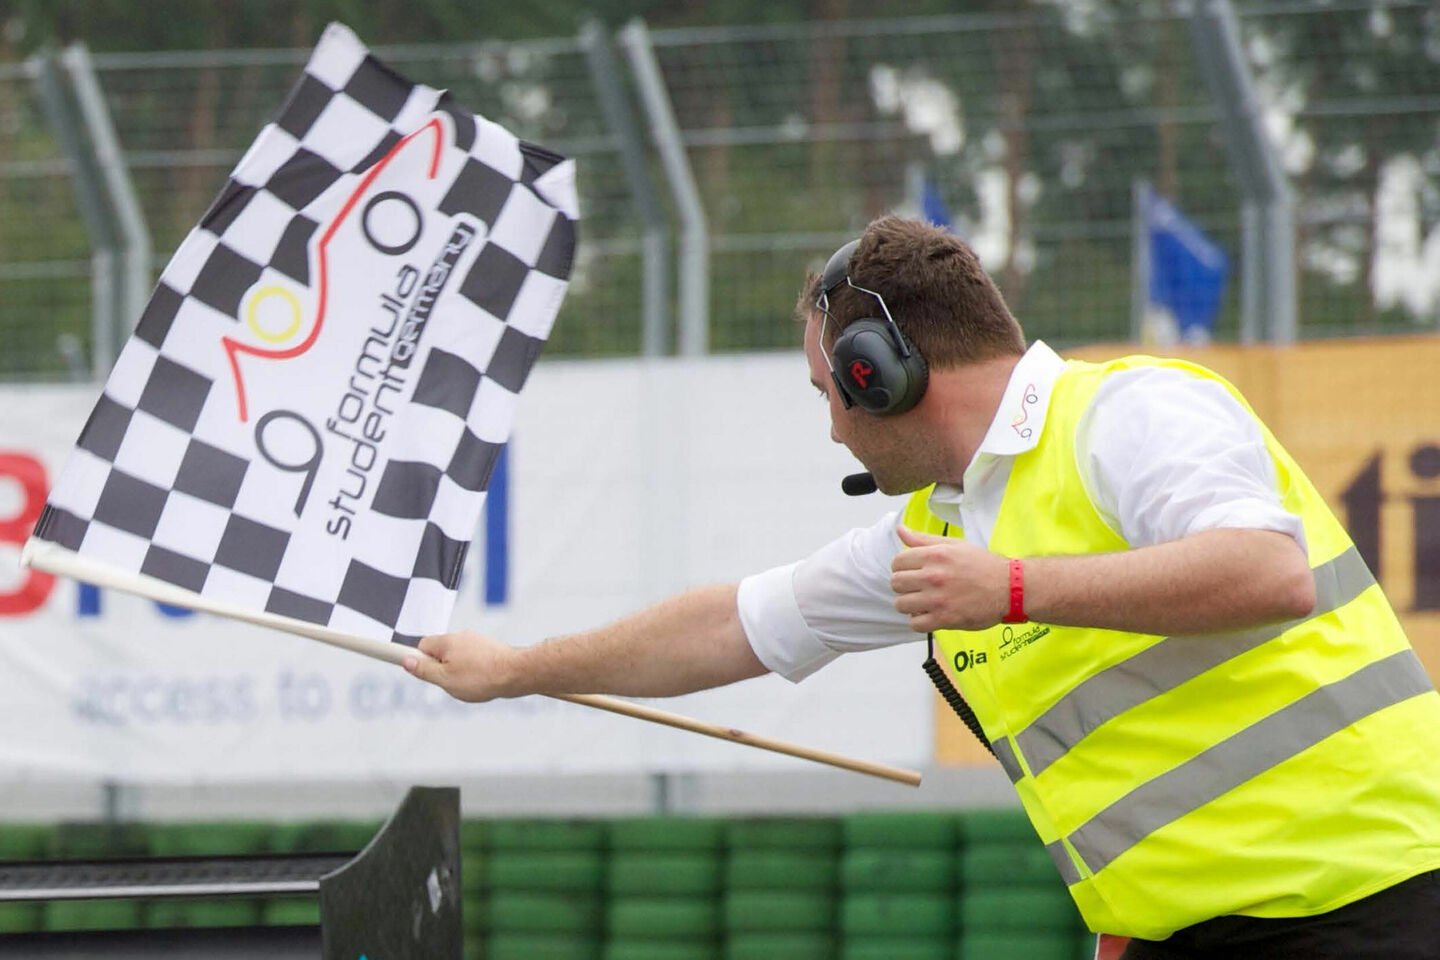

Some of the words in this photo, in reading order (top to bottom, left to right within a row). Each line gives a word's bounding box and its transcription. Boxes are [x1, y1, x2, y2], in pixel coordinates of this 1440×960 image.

[326, 264, 420, 441] formula
[326, 361, 406, 540] student
[278, 670, 332, 724] to
